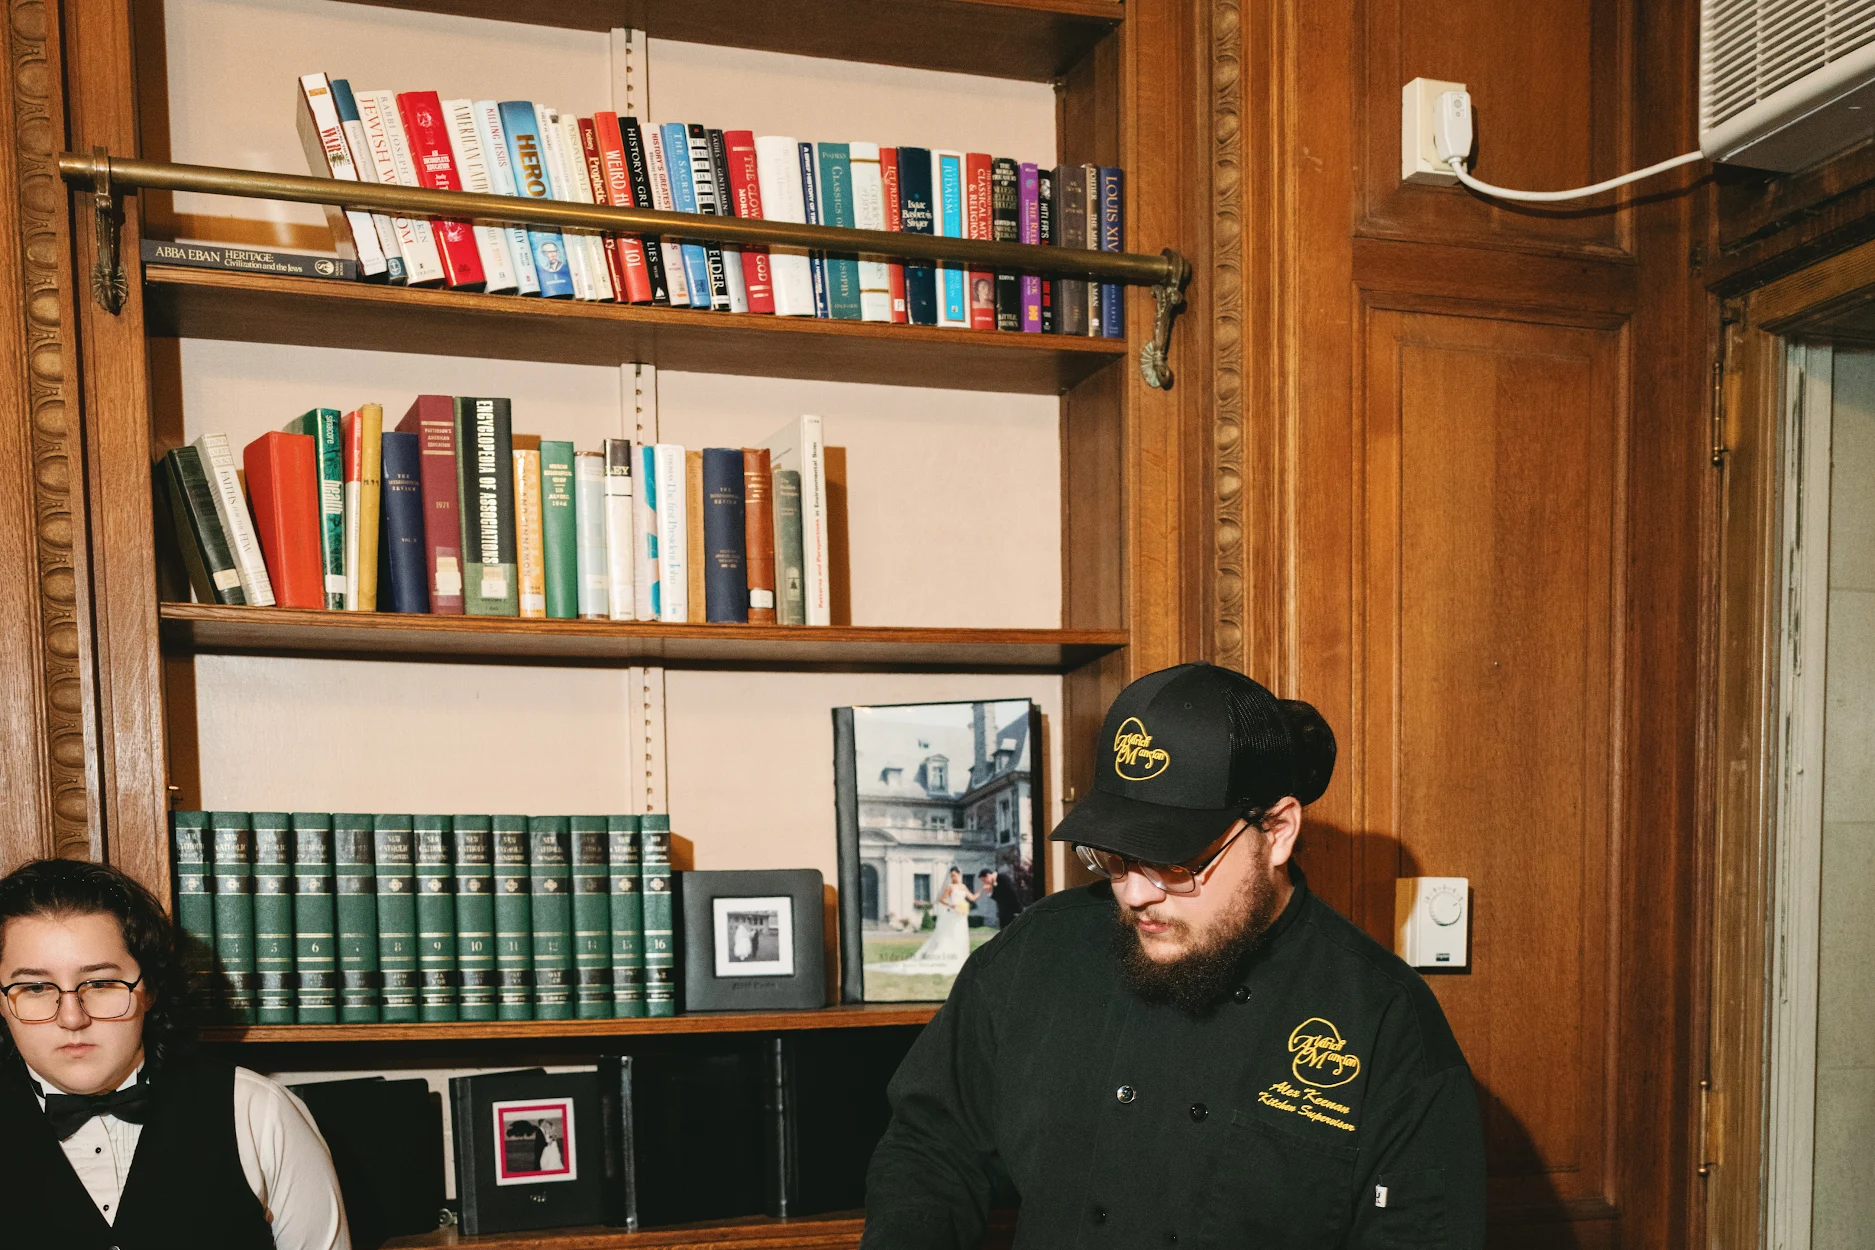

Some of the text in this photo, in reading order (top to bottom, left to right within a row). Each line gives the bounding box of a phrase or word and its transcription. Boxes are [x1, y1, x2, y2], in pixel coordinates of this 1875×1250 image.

[321, 127, 342, 153] WAR
[360, 98, 390, 163] JEWISH
[380, 96, 409, 176] RABBI JOSEPH
[453, 106, 480, 160] AMERICAN
[486, 108, 507, 168] KILLING JESUS
[674, 133, 683, 155] THE
[585, 128, 606, 204] Kelsey Prophetic
[652, 133, 671, 210] HISTORY'S GREATEST
[678, 160, 691, 203] SACRED
[712, 133, 728, 210] LADIES GENTLEMEN
[627, 128, 644, 182] HISTORY'S
[647, 242, 658, 262] LIES
[806, 173, 814, 202] HISTORY
[809, 202, 815, 212] OF
[832, 166, 843, 214] CLASSICS
[888, 166, 899, 225] LET FREEDOM
[908, 200, 926, 209] Isaac
[943, 165, 953, 214] JUDAISM
[977, 169, 987, 217] CLASSICAL
[606, 150, 627, 190] WEIRD
[625, 249, 641, 267] 101
[744, 155, 768, 281] THE CLOW GOD
[907, 219, 928, 230] Singer
[969, 184, 979, 239] & RELIGION
[1040, 202, 1049, 239] HITLER'S
[1105, 176, 1119, 252] LOUIS XIV
[155, 246, 220, 262] ABBA EBAN
[224, 259, 303, 273] Civilization and the Jews
[225, 250, 274, 263] HERITAGE:
[709, 250, 725, 288] ELDER
[323, 479, 343, 514] health
[476, 400, 499, 564] ENCYCLOPEDIA OF ASSOCIATIONS
[220, 470, 236, 506] FAITHS
[239, 532, 252, 553] FEW
[436, 501, 450, 509] 1971
[522, 518, 530, 577] CINNAMON
[271, 942, 278, 953] 5
[312, 942, 319, 953] 6
[394, 942, 402, 952] 8
[433, 941, 441, 951] 9
[471, 941, 482, 951] 10
[509, 941, 518, 951] 11
[654, 939, 666, 949] 16
[1258, 1091, 1356, 1132] Kitchen Supervisor
[1269, 1081, 1350, 1114] Alex Keenan
